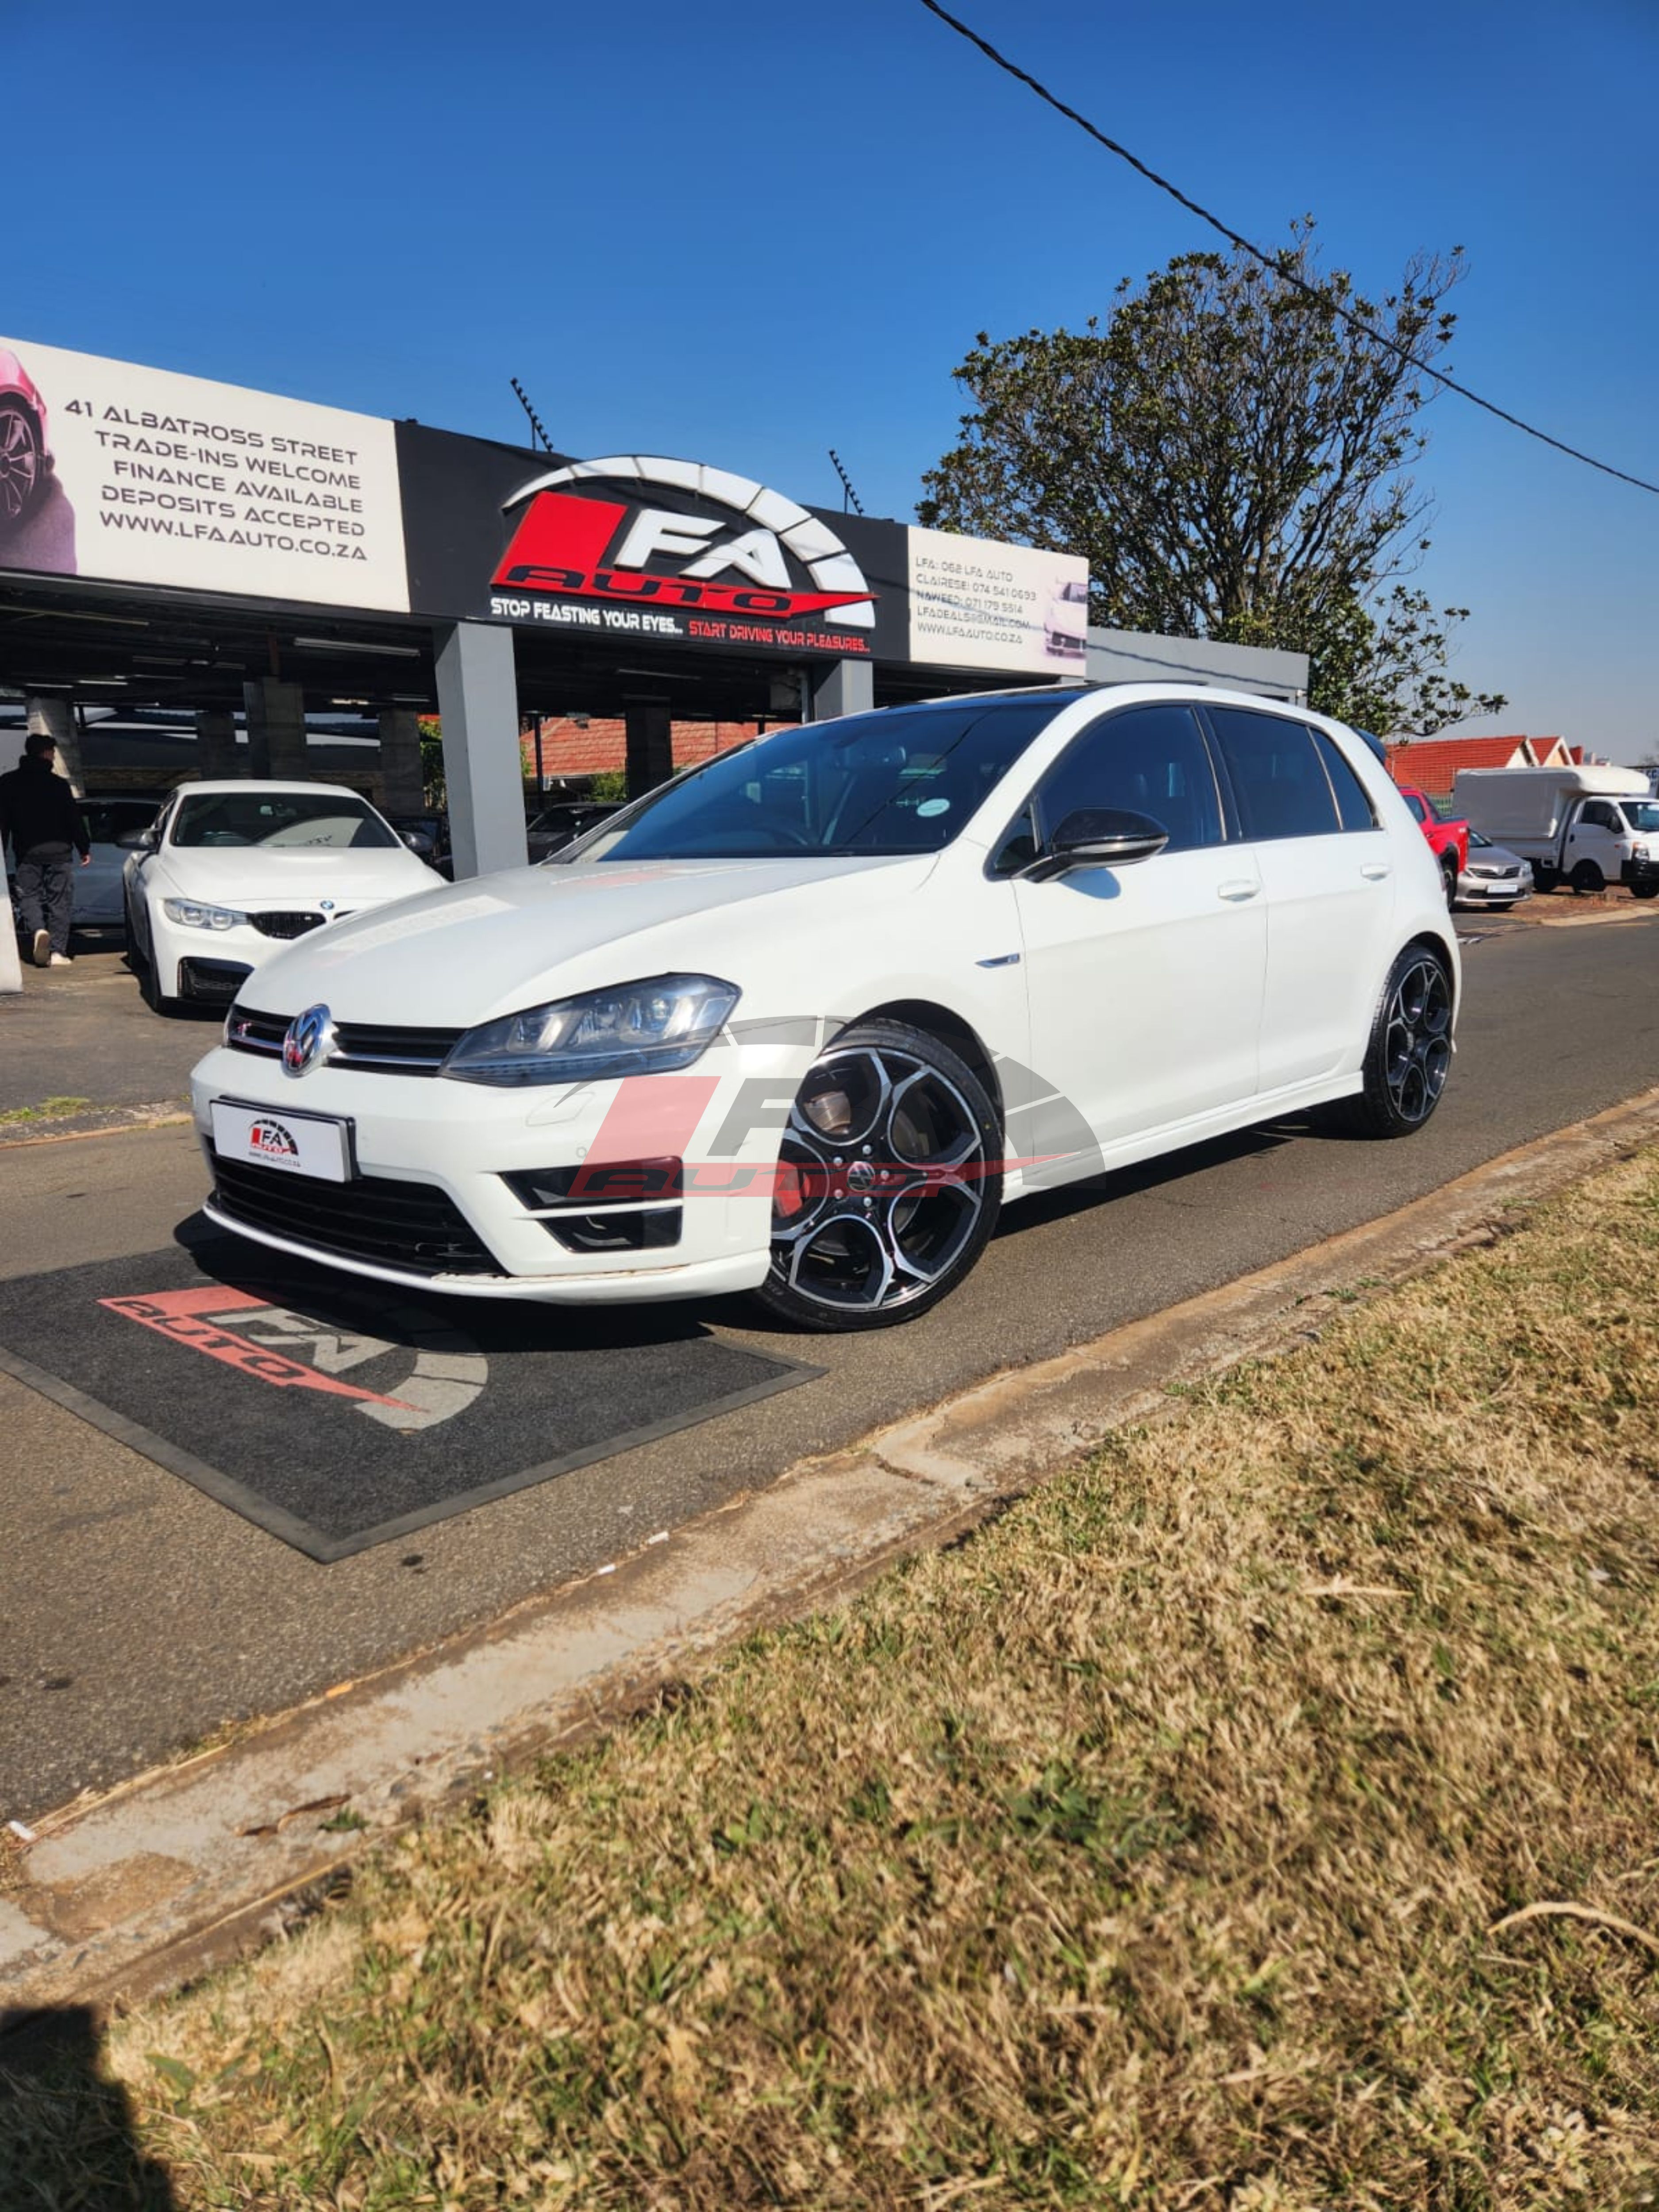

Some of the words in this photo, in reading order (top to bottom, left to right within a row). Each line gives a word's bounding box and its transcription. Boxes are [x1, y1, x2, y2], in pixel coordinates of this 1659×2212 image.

[64, 399, 93, 417] 41
[103, 406, 264, 448] ALBATROSS
[272, 437, 358, 465] STREET
[95, 431, 238, 468] TRADE-INS
[246, 457, 360, 489] WELCOME
[101, 485, 235, 518] DEPOSITS
[244, 508, 365, 536] ACCEPTED
[114, 461, 226, 492] FINANCE
[235, 481, 362, 513] AVAILABLE
[100, 512, 367, 560] WWW.LFAAUTO.CO.ZA
[505, 565, 792, 612] AUTO
[965, 566, 983, 577] LFA
[986, 569, 1013, 582] AUTO
[973, 583, 990, 594] 074
[491, 597, 530, 616] STOP
[533, 602, 600, 625] FEASTING
[603, 610, 639, 629] YOUR
[965, 597, 981, 609] 071
[689, 621, 726, 638] START
[730, 625, 772, 642] DRIVING
[776, 630, 803, 646] YOUR
[917, 622, 1023, 643] WWW.LFAAUTO.CO.ZA
[112, 1301, 306, 1378] AUTO
